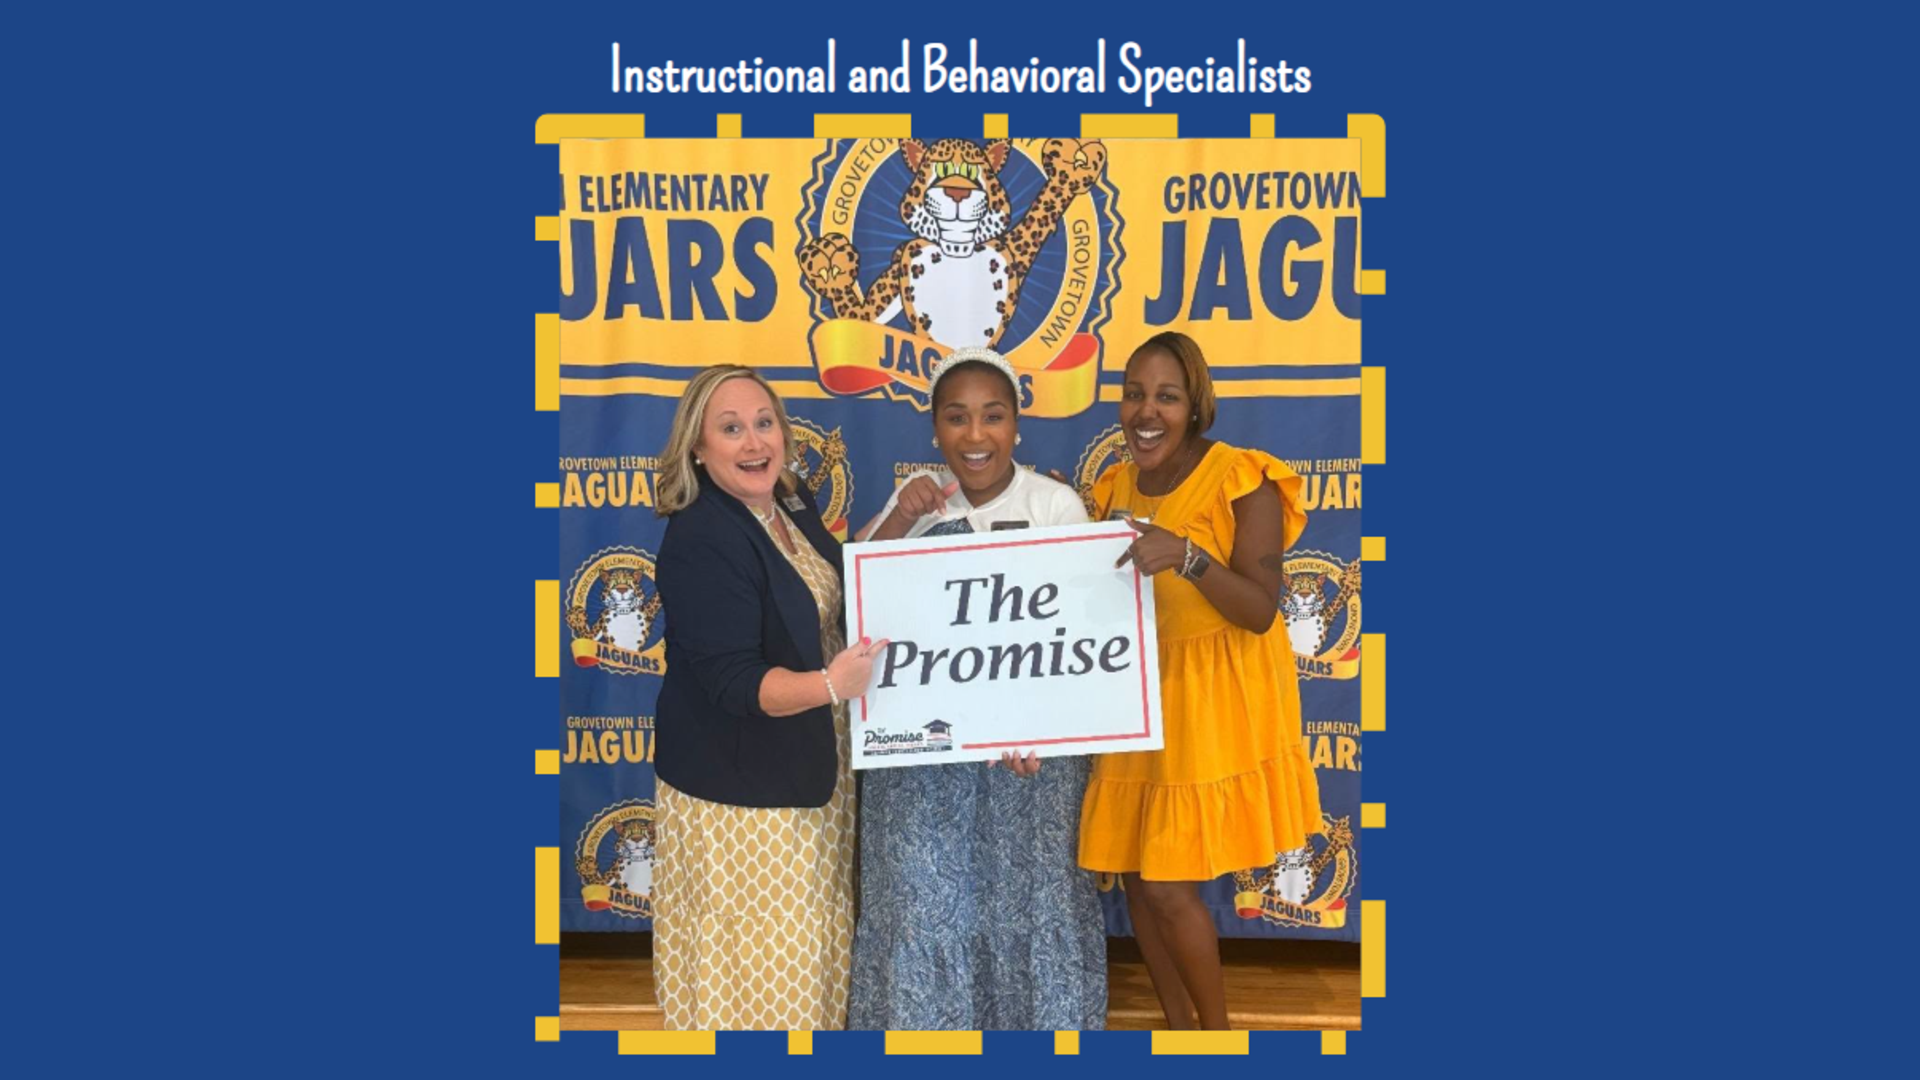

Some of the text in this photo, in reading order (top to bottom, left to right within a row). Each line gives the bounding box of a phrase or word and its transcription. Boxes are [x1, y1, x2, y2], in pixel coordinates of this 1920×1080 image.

[579, 172, 770, 213] ELEMENTARY
[832, 138, 898, 226] GROVETO
[1164, 172, 1362, 214] GROVETOWN
[559, 216, 778, 322] UARS
[1039, 219, 1091, 349] GROVETOWN
[1144, 215, 1362, 326] JAGU
[944, 573, 1060, 627] The
[595, 643, 660, 672] JAGUARS
[877, 627, 1131, 689] Promise
[566, 716, 634, 729] GROVETOWN
[864, 729, 924, 747] Promise
[1260, 896, 1322, 924] JAGUARS
